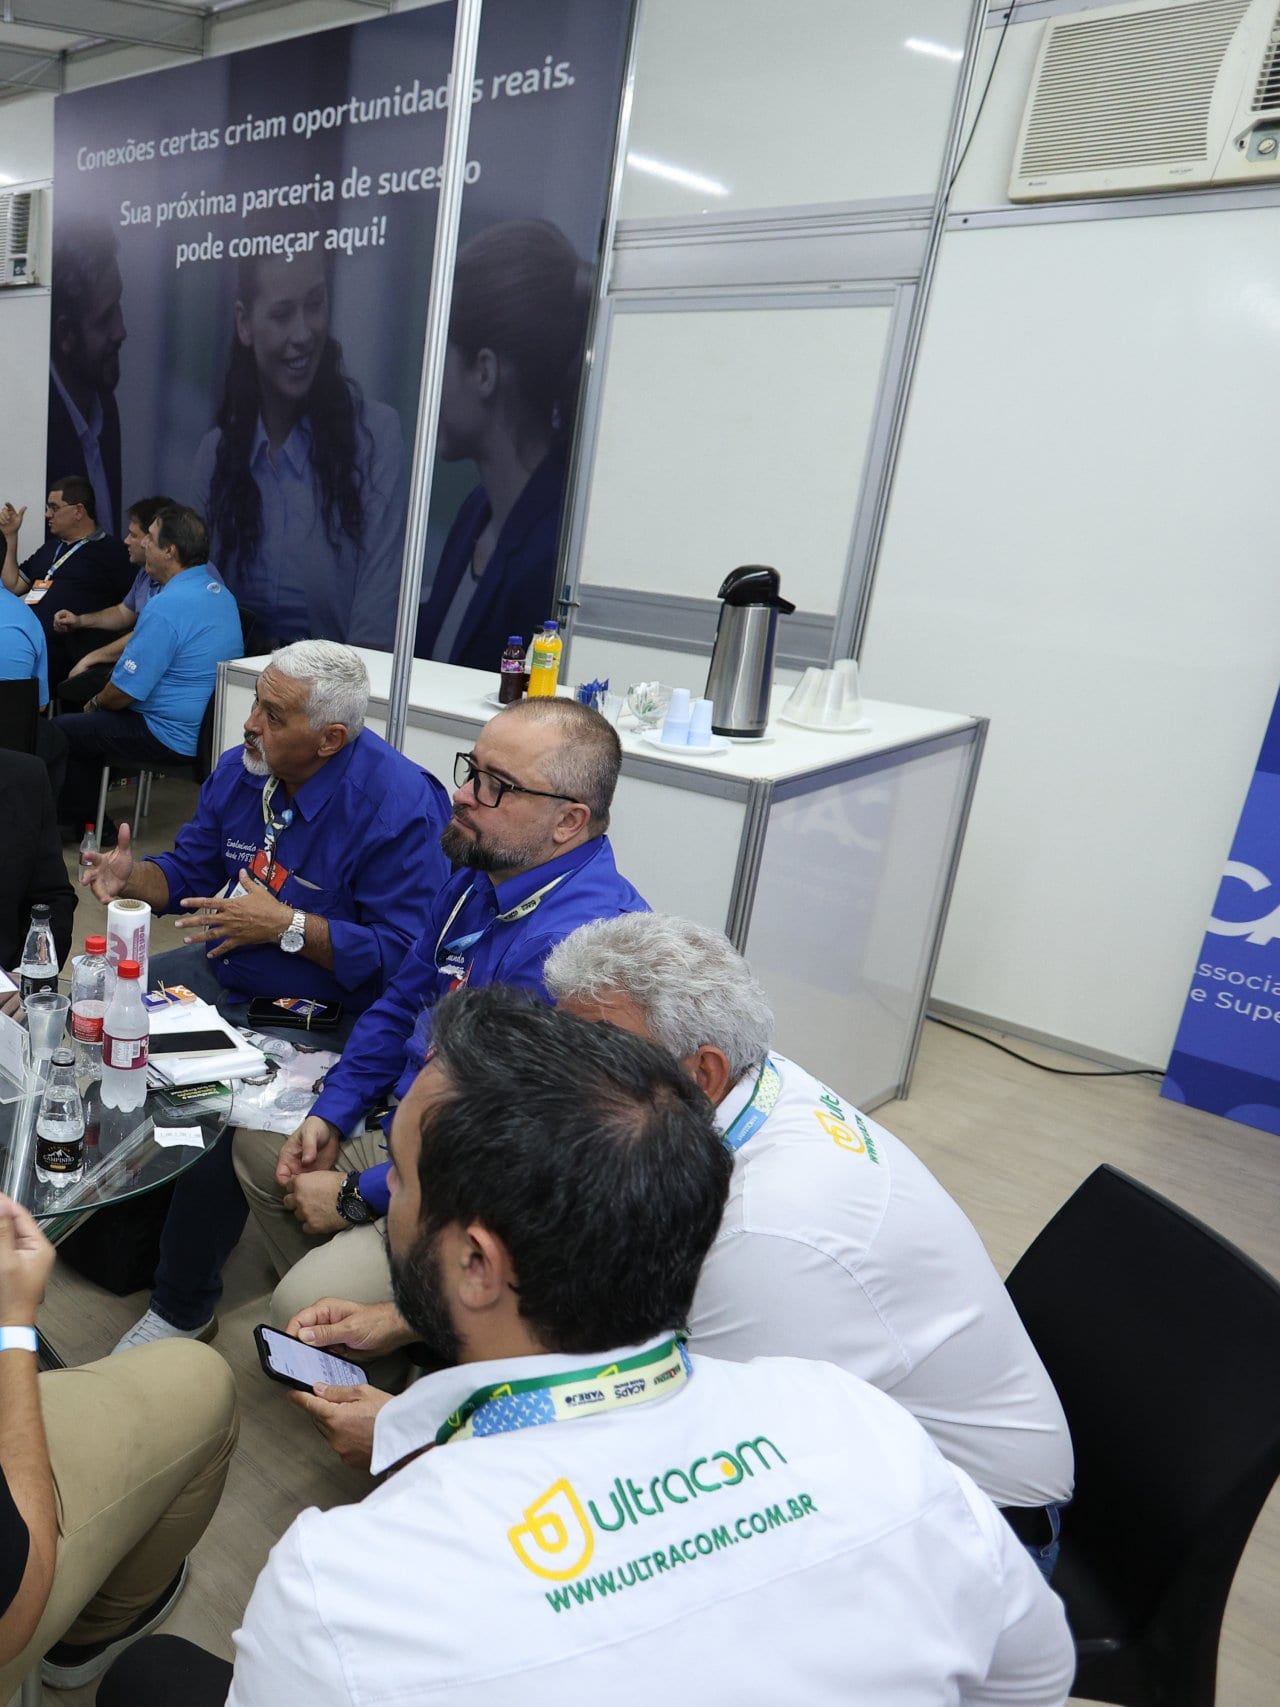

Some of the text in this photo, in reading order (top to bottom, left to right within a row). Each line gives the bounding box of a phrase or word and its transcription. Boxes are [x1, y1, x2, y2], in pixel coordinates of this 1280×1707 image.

[77, 55, 575, 171] Conexões certas criam oportunidads reais.
[120, 160, 481, 228] Sua próxima parceria de suceso
[176, 215, 387, 269] pode começar aqui!
[1190, 986, 1207, 1002] e
[545, 1491, 818, 1613] WWW.ULTRACOM.COM.BR
